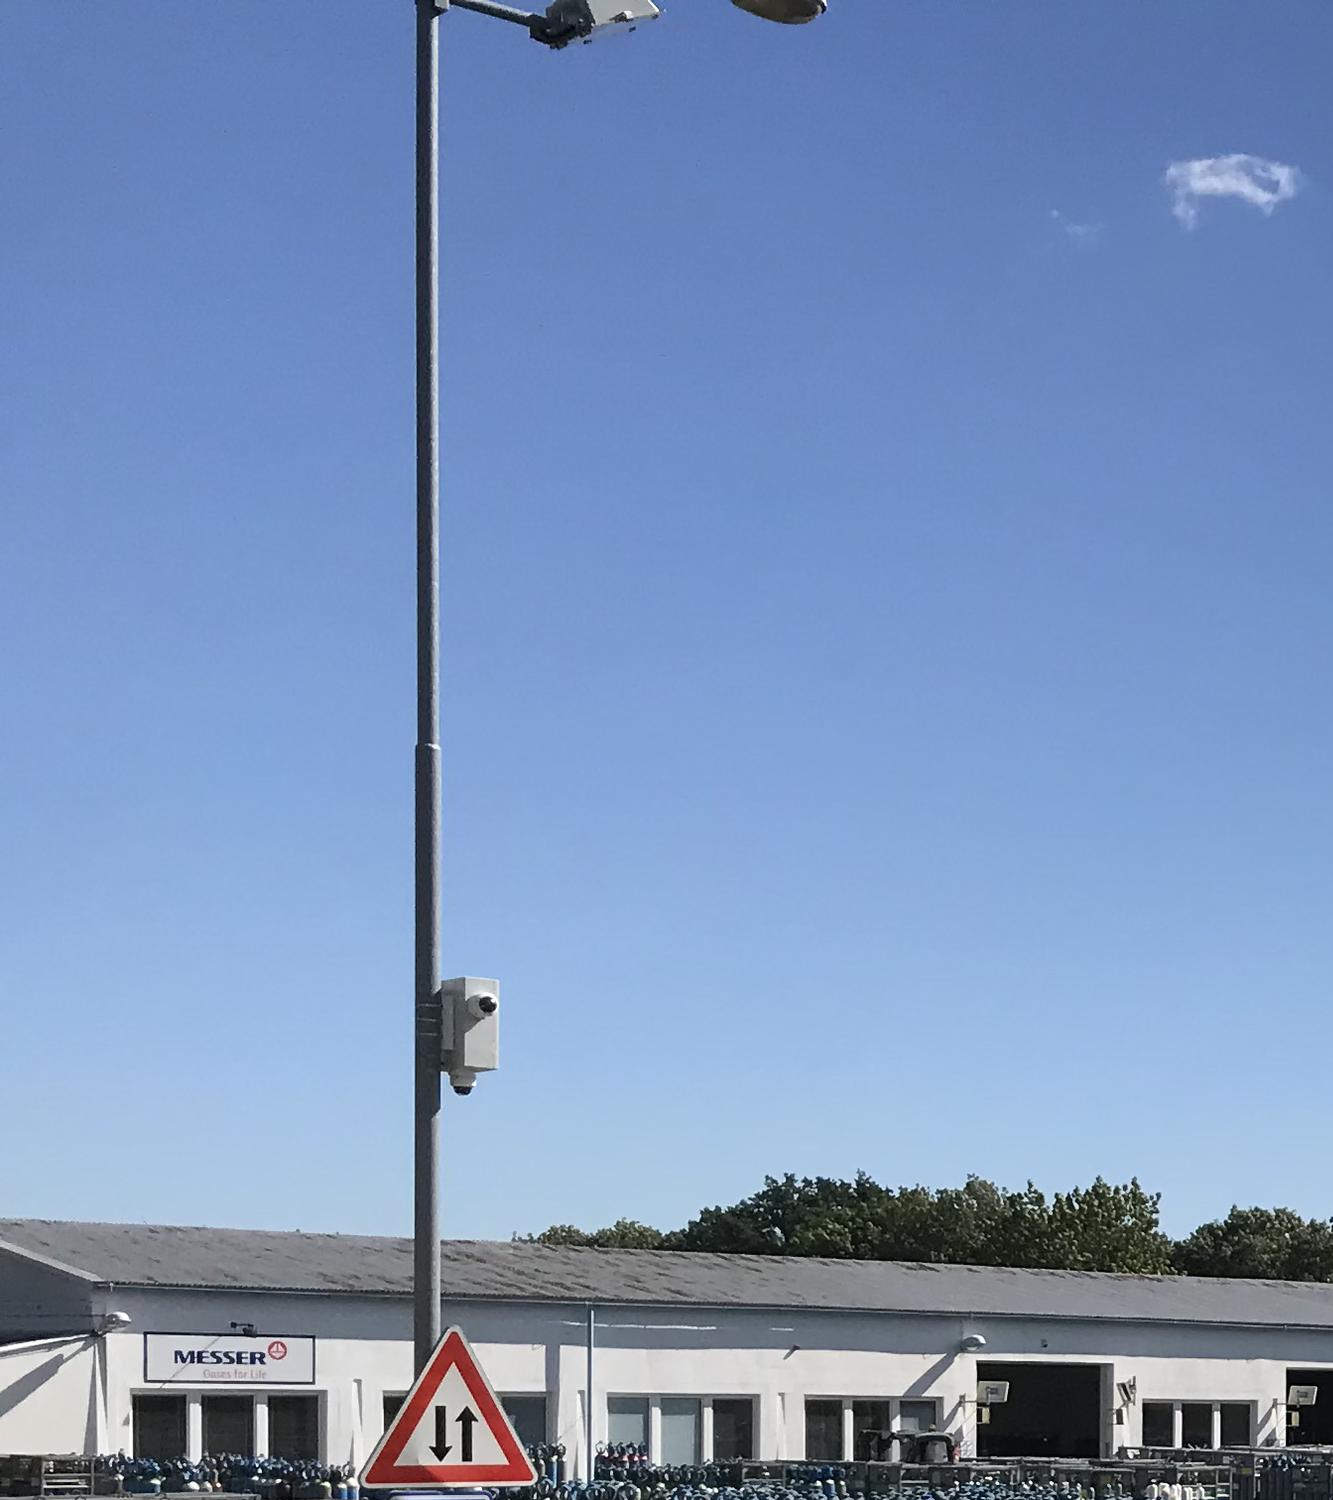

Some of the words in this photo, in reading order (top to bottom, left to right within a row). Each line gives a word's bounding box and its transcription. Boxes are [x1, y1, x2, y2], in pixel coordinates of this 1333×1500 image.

[174, 1350, 266, 1365] MESSER
[203, 1368, 231, 1379] Gases
[234, 1368, 249, 1379] for
[250, 1368, 268, 1379] Life
